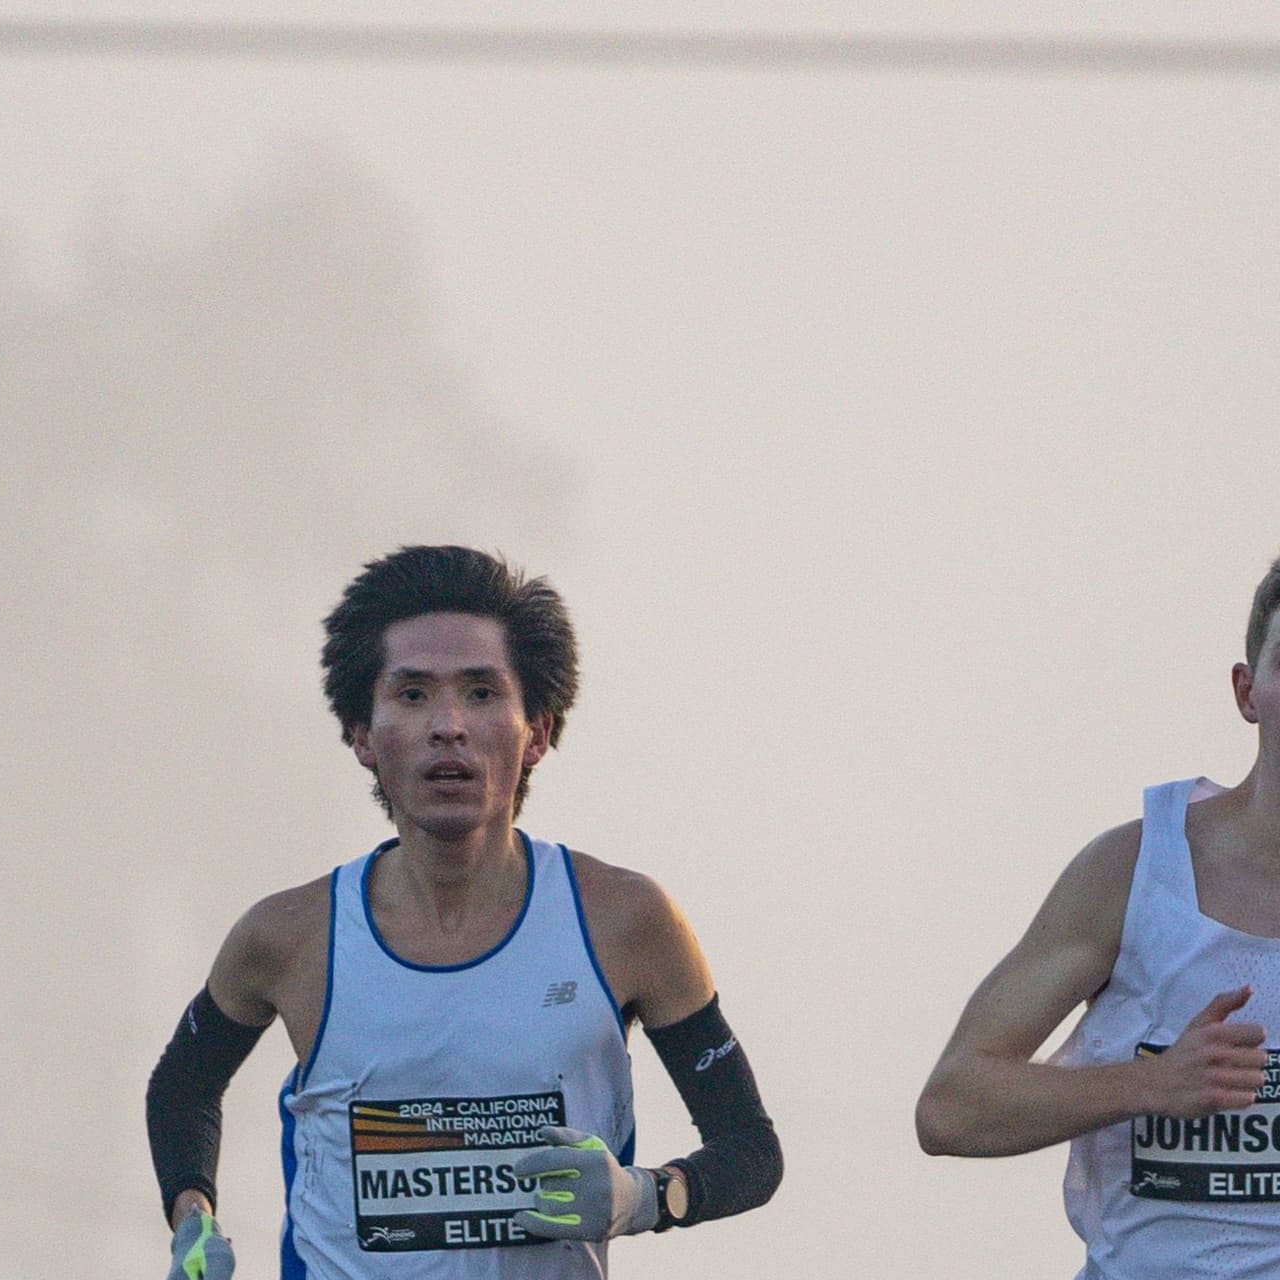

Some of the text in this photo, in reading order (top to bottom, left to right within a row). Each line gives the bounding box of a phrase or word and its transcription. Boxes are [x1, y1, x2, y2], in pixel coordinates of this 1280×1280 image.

[399, 1102, 443, 1118] 2024
[457, 1096, 559, 1116] CALIFORNIA
[426, 1112, 559, 1132] INTERNATIONAL
[464, 1129, 545, 1146] MARATHO
[444, 1217, 527, 1244] ELITE
